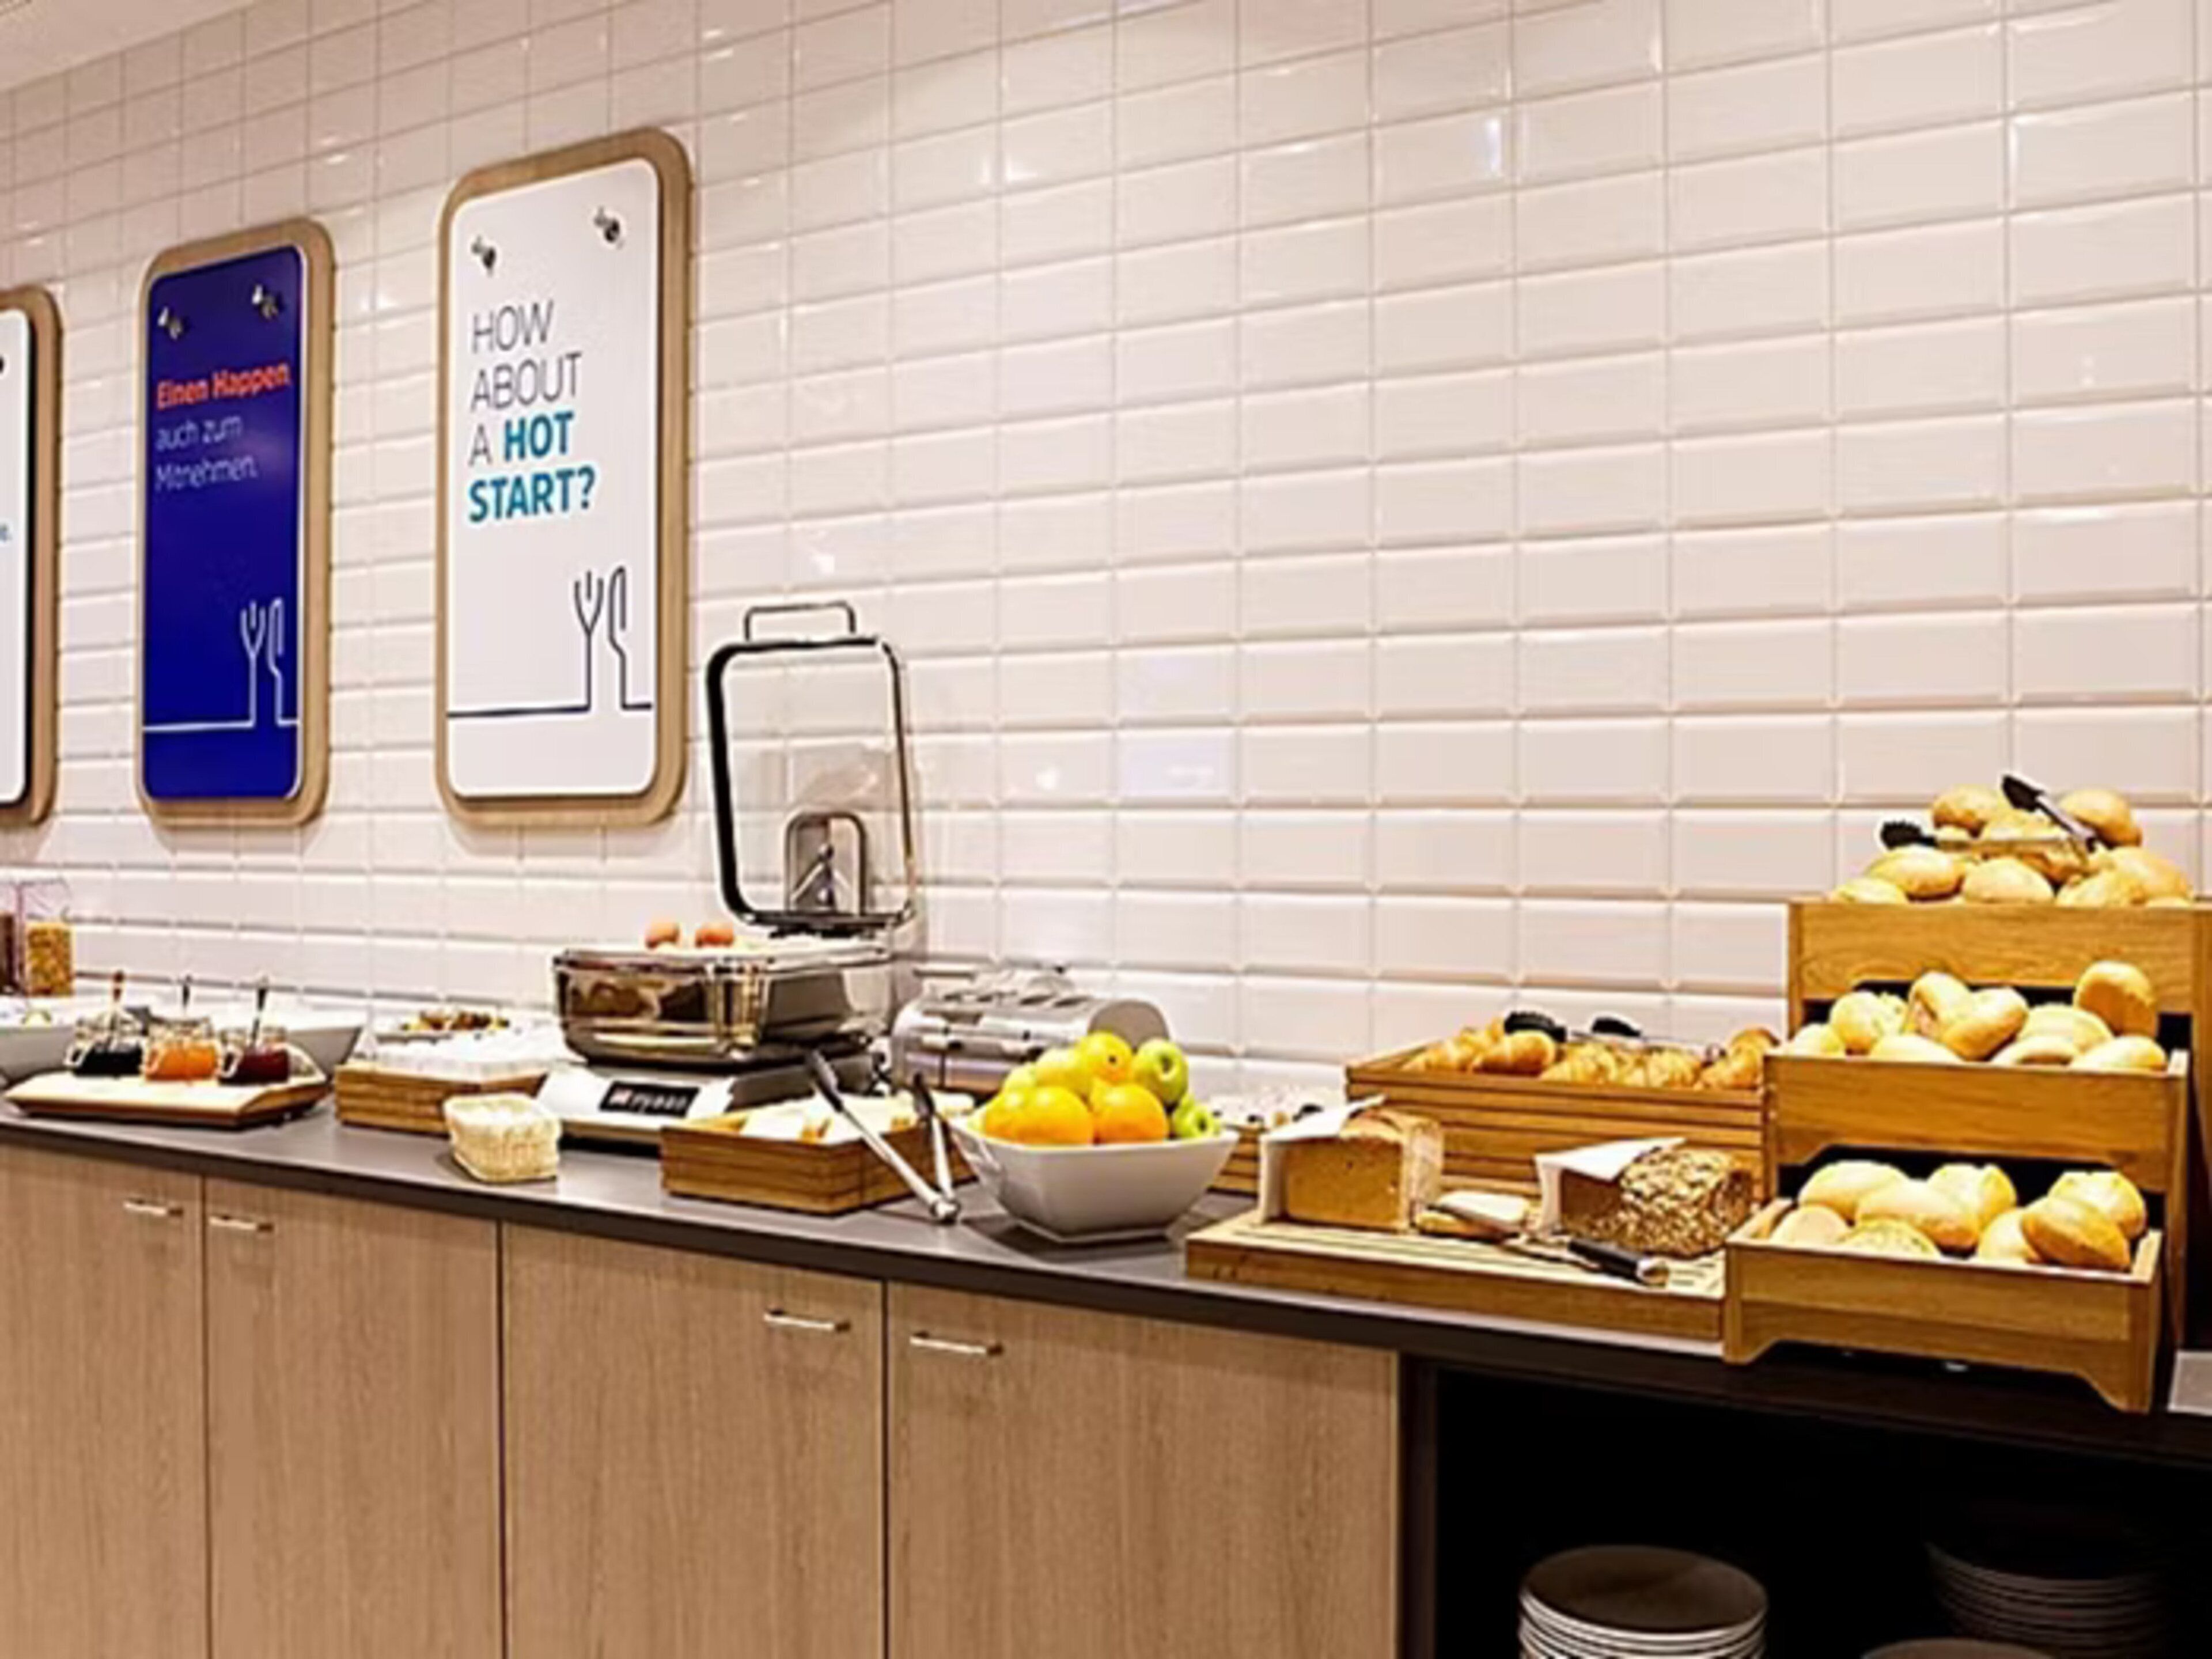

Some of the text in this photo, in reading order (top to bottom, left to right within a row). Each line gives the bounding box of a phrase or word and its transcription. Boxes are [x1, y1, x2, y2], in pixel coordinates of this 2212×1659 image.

[473, 300, 554, 353] HOW
[157, 362, 290, 410] Einen Happen
[471, 351, 582, 411] ABOUT
[156, 415, 241, 451] auch zum
[468, 411, 574, 465] A HOT
[468, 465, 596, 522] START?
